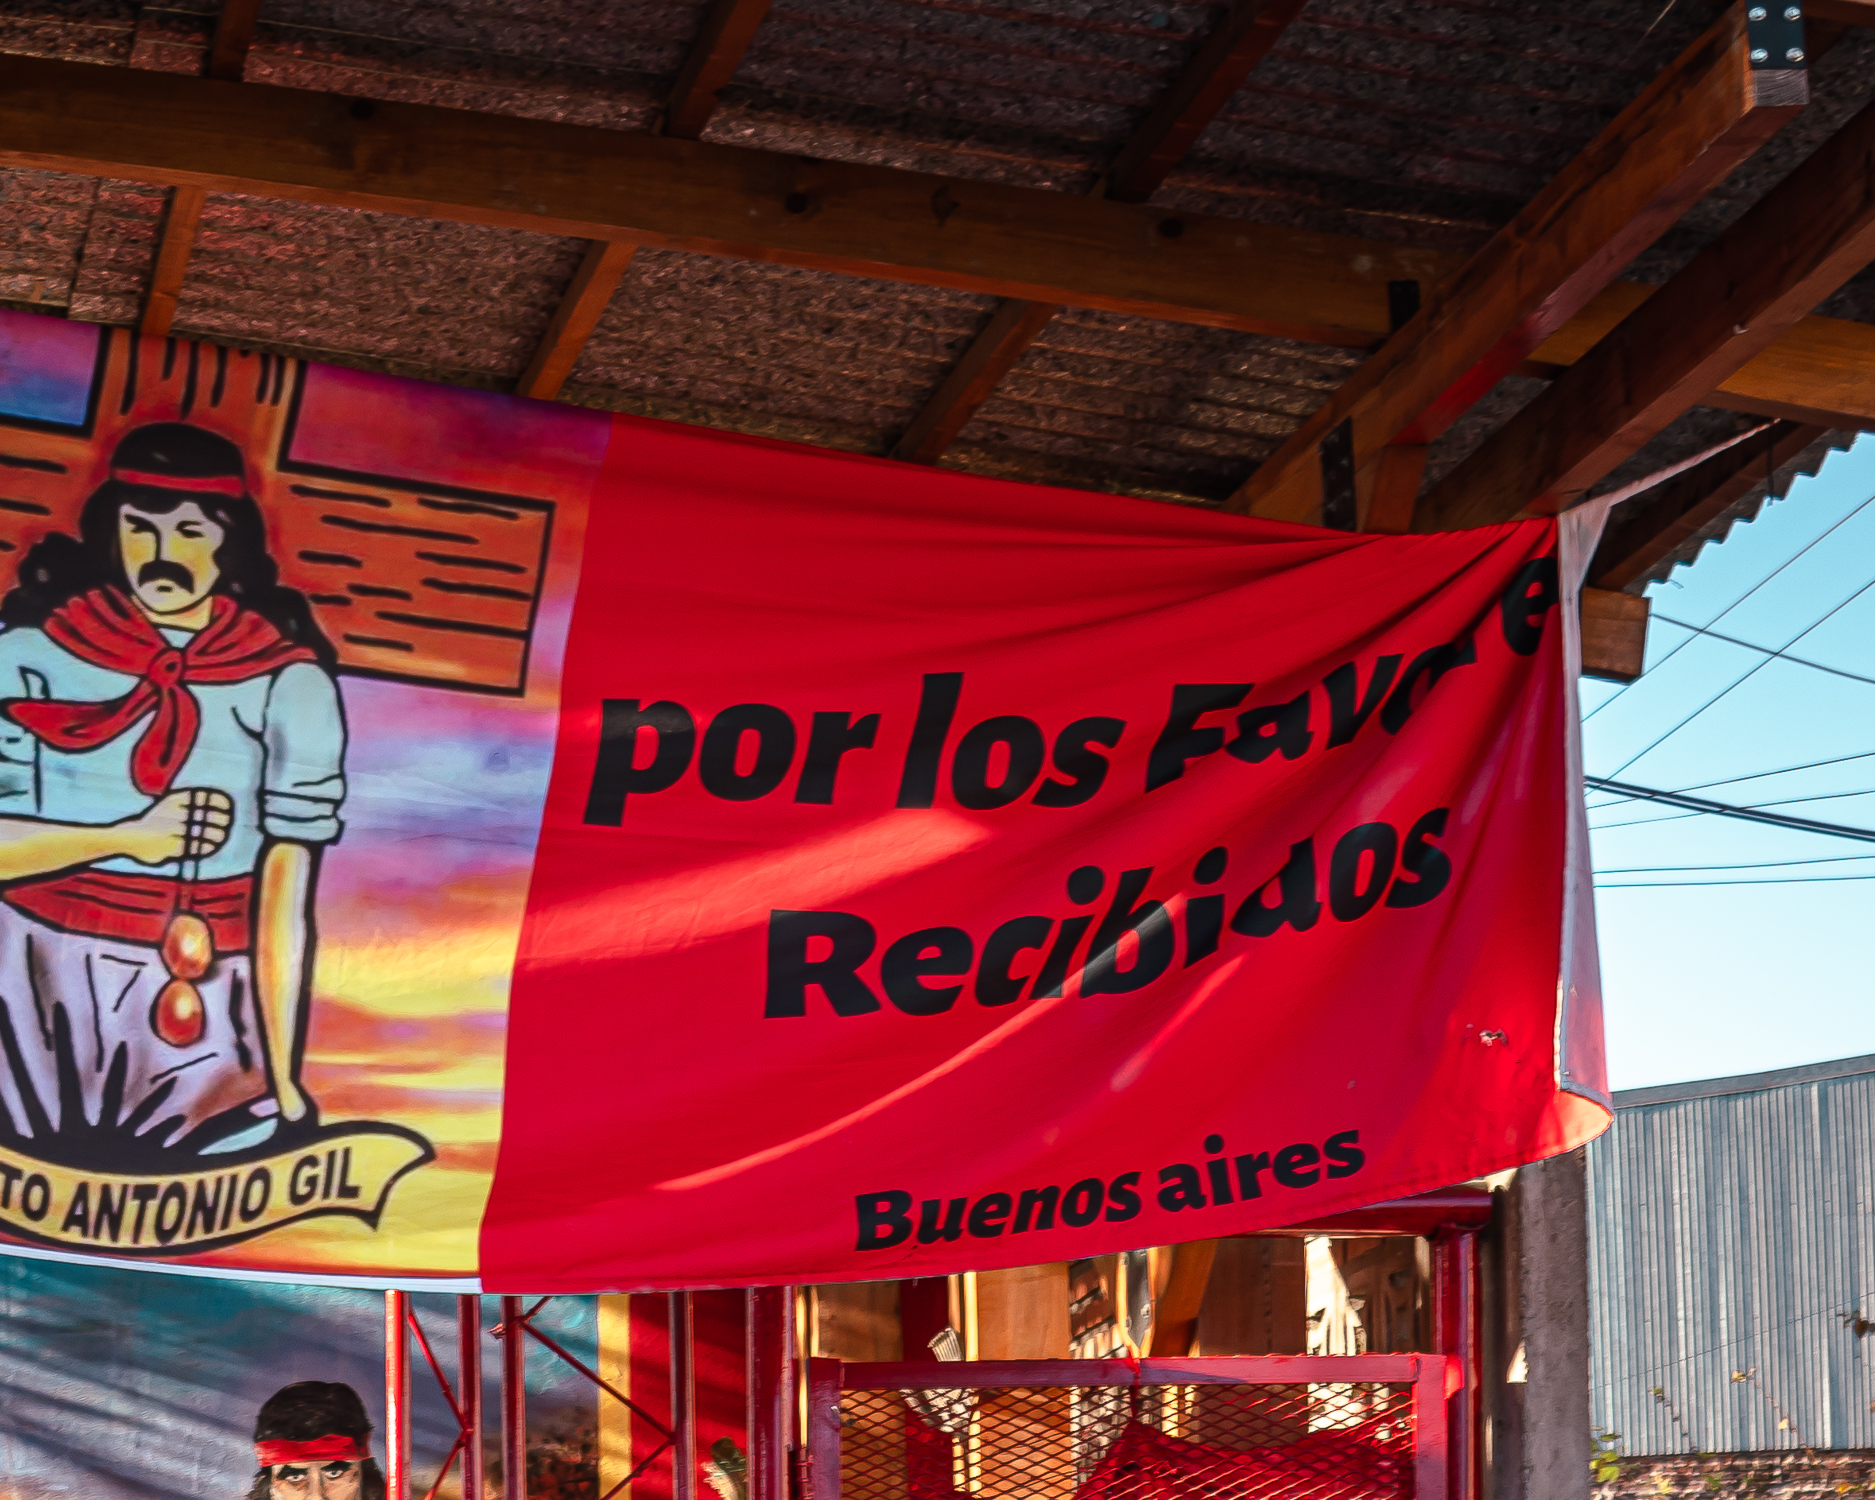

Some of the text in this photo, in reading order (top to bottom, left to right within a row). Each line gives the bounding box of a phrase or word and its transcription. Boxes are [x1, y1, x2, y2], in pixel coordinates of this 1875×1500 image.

[582, 699, 881, 827] por
[895, 671, 1126, 811] los
[763, 807, 1452, 1020] Recibidos
[61, 1166, 271, 1246] ANTONIO
[289, 1145, 361, 1206] GIL
[855, 1130, 1366, 1252] Buenos aires
